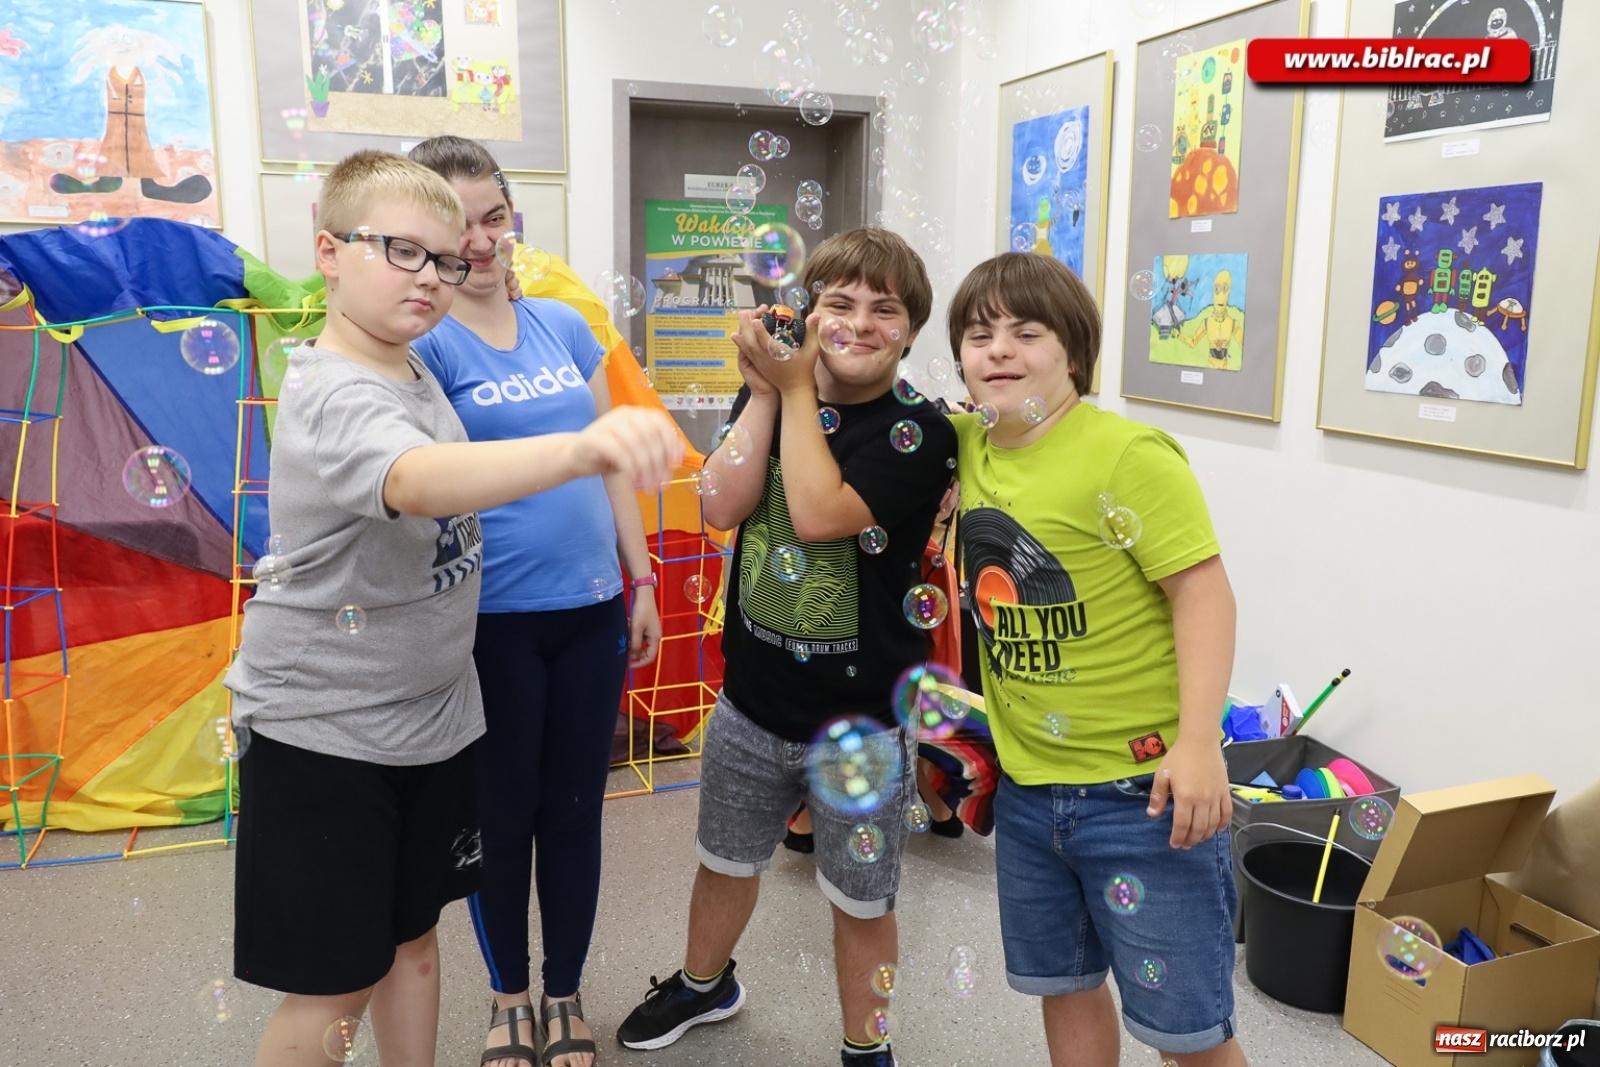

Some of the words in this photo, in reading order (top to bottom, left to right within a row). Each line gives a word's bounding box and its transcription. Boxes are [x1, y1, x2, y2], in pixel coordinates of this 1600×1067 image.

[671, 234, 686, 246] W
[996, 605, 1031, 639] ALL
[1034, 602, 1087, 641] YOU
[811, 643, 830, 653] DRUM
[832, 640, 856, 652] TRACKS
